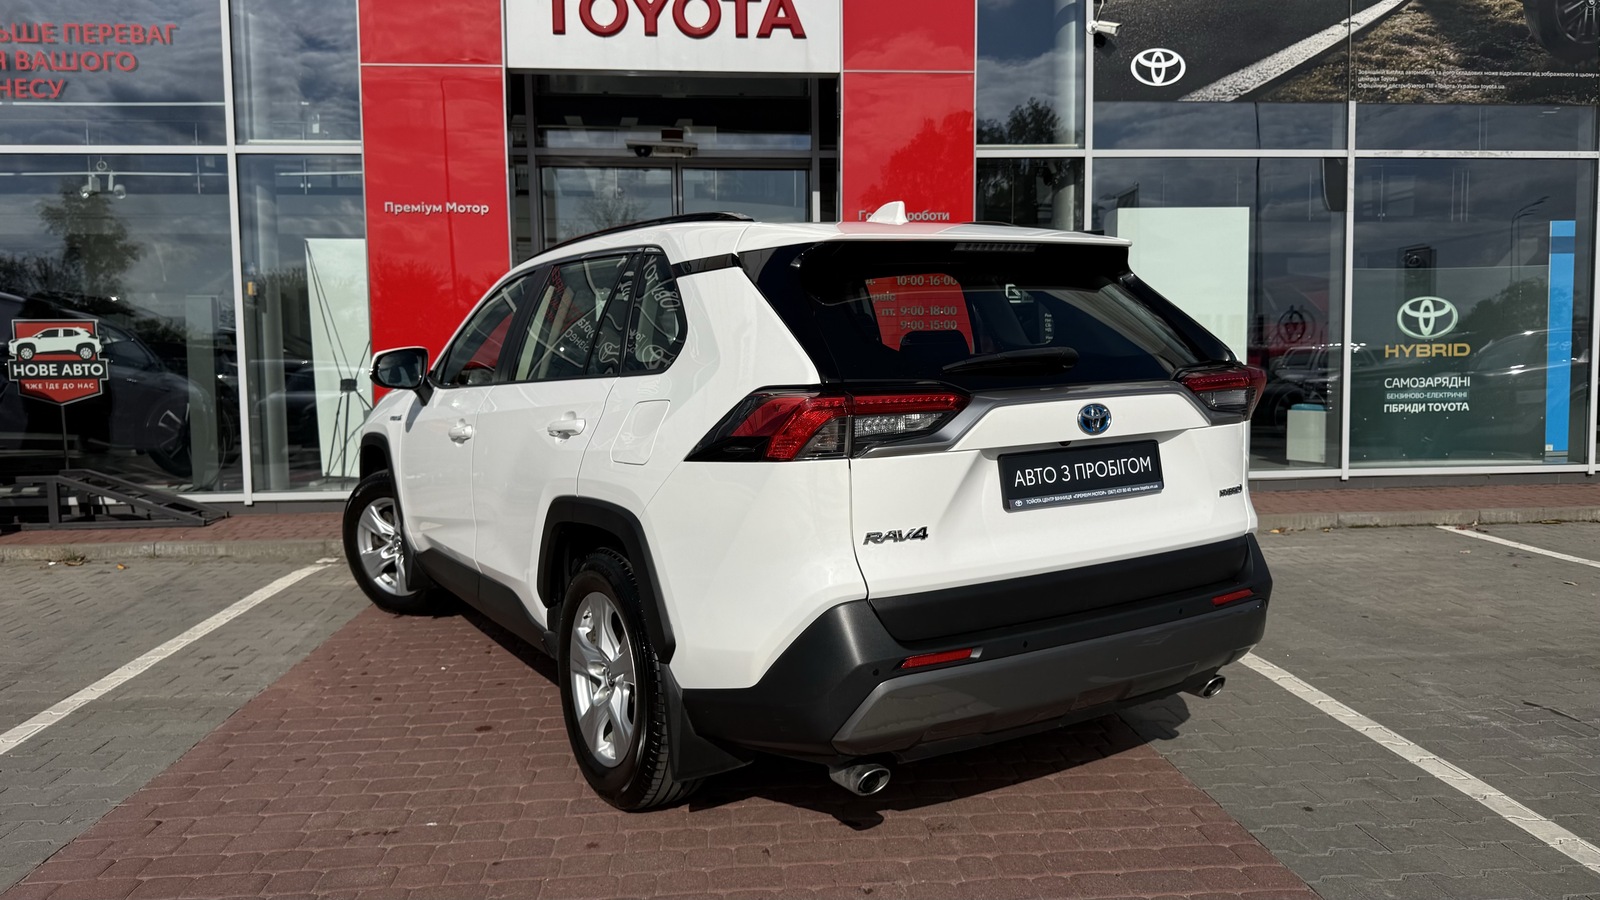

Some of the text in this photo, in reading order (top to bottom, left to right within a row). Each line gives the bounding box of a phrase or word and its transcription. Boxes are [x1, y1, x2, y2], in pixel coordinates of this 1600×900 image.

[552, 0, 807, 38] TOYOTA
[63, 24, 177, 44] ПЕРЕВАГ
[15, 50, 136, 71] ВАШОГО
[384, 201, 489, 216] Преміум Мотор
[907, 209, 950, 221] роботи
[872, 291, 896, 303] рвіс
[1384, 343, 1471, 358] HYBRID
[13, 363, 104, 377] НОВЕ АВТО
[46, 382, 59, 390] ЇДЕ
[62, 382, 75, 390] ДО
[1384, 376, 1471, 389] САМОЗАРЯДНІ
[1386, 391, 1468, 400] БЕНЗИНОВО-ЕЛЕКТРИЧНІ
[1384, 402, 1470, 413] ГІБРИДИ TOYOTA
[1014, 455, 1152, 488] АВТО З ПРОБІГОМ
[863, 526, 928, 545] RAV4
